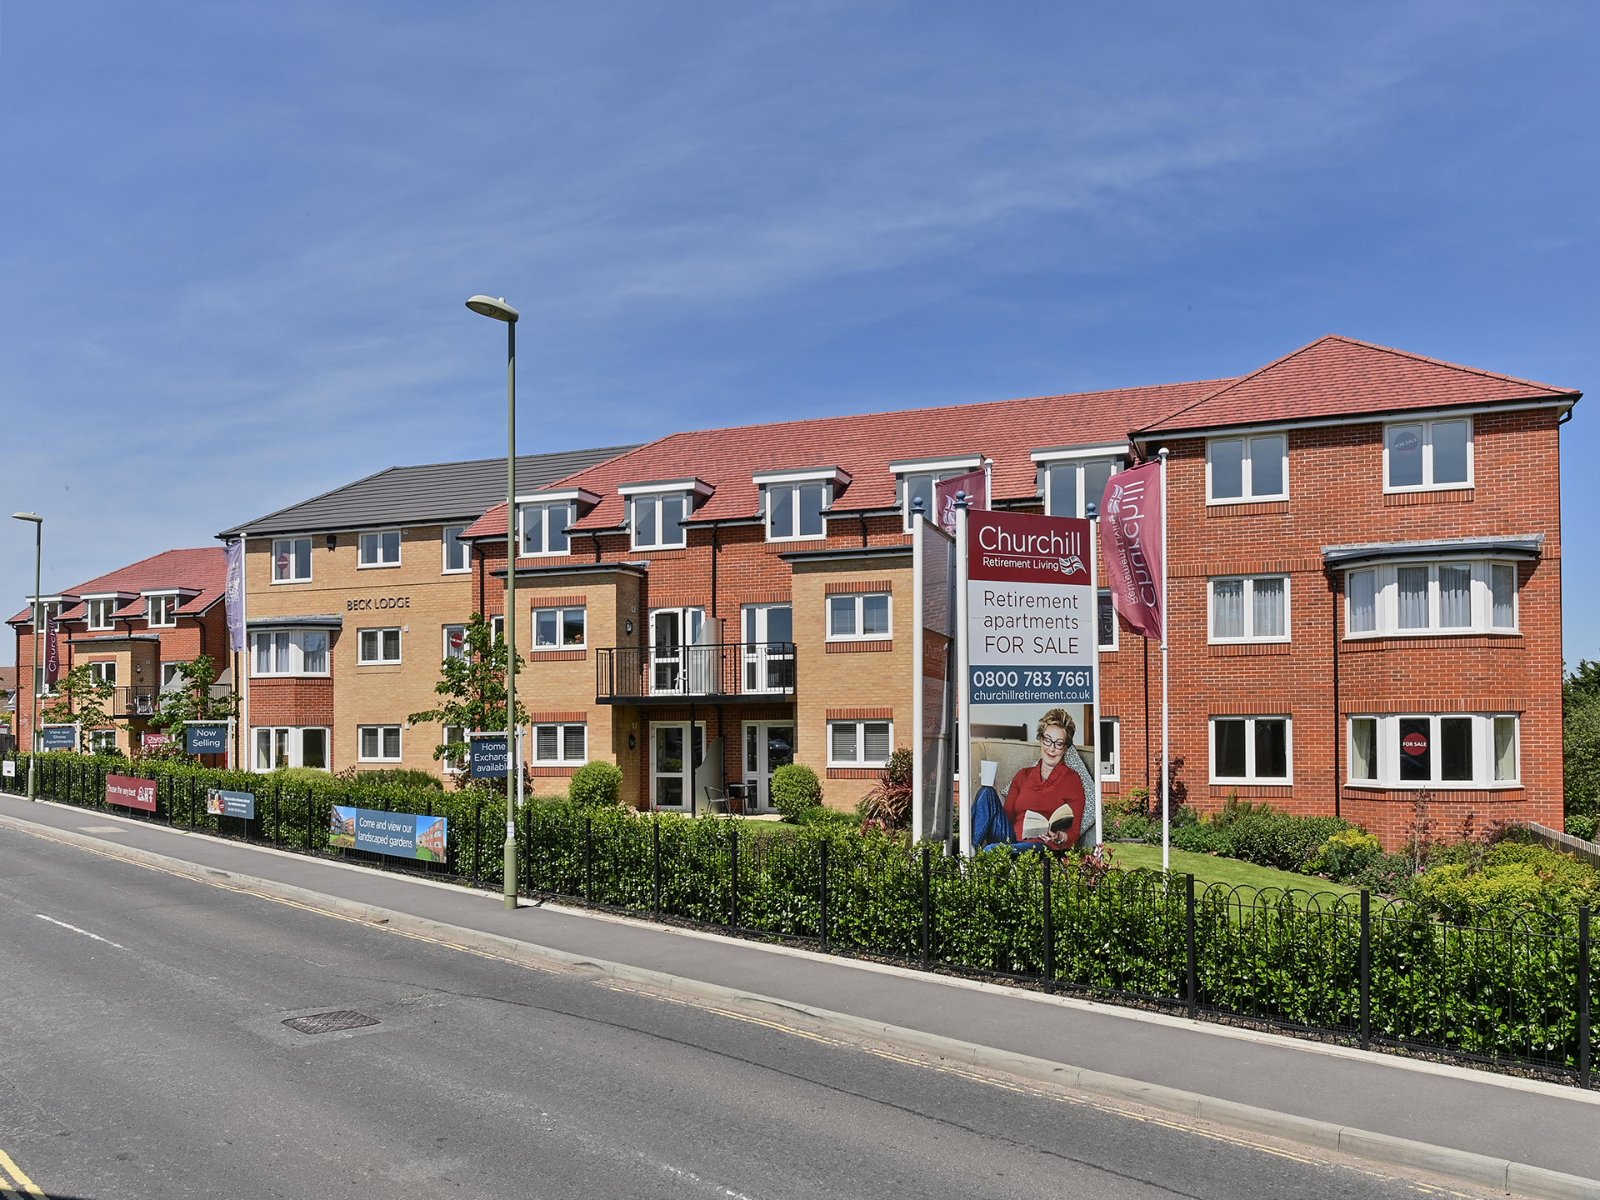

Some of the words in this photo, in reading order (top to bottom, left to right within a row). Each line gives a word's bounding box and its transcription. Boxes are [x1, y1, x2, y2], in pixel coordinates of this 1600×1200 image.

[978, 525, 1081, 556] Churchill
[983, 556, 1031, 569] Retirement
[1033, 559, 1059, 572] Living
[347, 598, 372, 611] BECK
[374, 596, 410, 610] LODGE
[984, 590, 1079, 610] Retirement
[983, 614, 1079, 631] apartments
[48, 618, 57, 672] Churchill
[985, 635, 1024, 654] FOR
[1033, 636, 1079, 654] SALE
[973, 671, 1018, 687] 0800
[1023, 671, 1052, 687] 783
[1056, 671, 1090, 688] 7661
[973, 689, 1091, 701] churchillretirement.co.uk
[196, 729, 217, 737] Now
[192, 738, 221, 747] Selling
[481, 743, 506, 751] Home
[474, 753, 508, 763] Exchang
[476, 763, 508, 772] availabl
[359, 817, 375, 829] Come
[376, 820, 387, 830] and
[387, 822, 401, 832] view
[402, 824, 413, 833] our
[358, 830, 389, 845] landscaped
[389, 836, 413, 849] gardens
